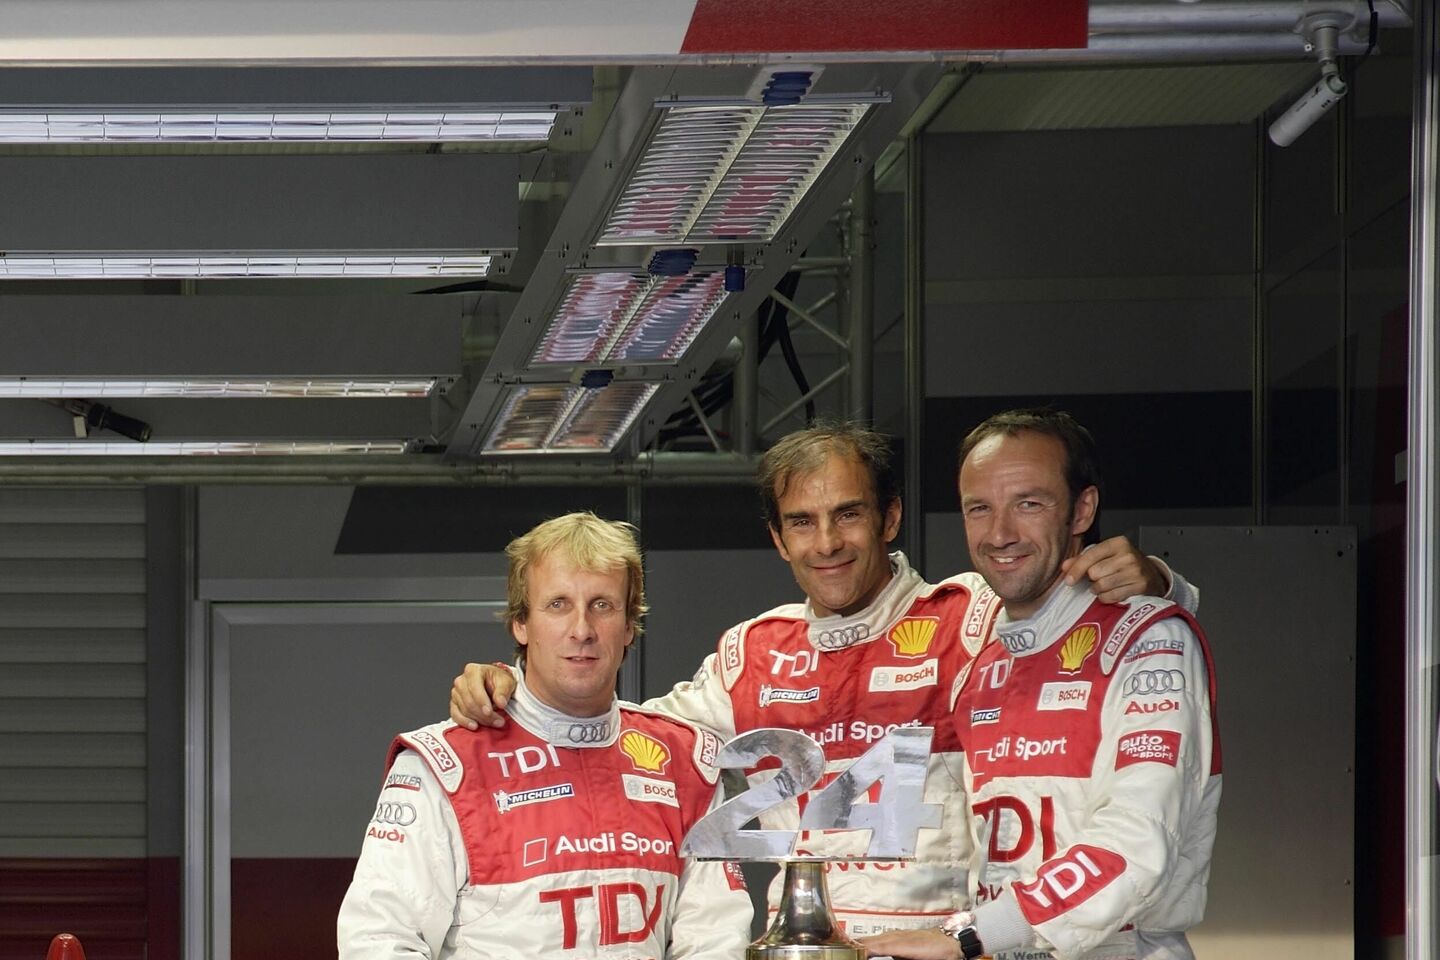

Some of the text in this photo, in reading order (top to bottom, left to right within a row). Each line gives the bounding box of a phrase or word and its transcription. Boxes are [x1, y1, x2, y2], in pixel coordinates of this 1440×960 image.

[1104, 605, 1154, 655] sparco
[768, 650, 818, 678] TDI
[895, 667, 934, 684] BOSCH
[979, 656, 1015, 692] TDI
[771, 689, 817, 701] MICHELIN
[1058, 689, 1087, 702] BOSCH
[1124, 699, 1180, 716] Audi
[415, 731, 456, 771] sparco
[1015, 736, 1067, 761] Sport
[1121, 733, 1163, 750] auto
[1126, 744, 1170, 755] motor
[488, 743, 561, 778] TDI
[512, 786, 570, 804] MICHELIN
[679, 727, 944, 858] 24
[368, 825, 405, 843] Audi
[971, 796, 1057, 863] TDI
[555, 831, 673, 856] Audi Spor
[1021, 851, 1103, 908] TDI
[539, 881, 665, 951] TDI
[1015, 950, 1053, 960] Werne
